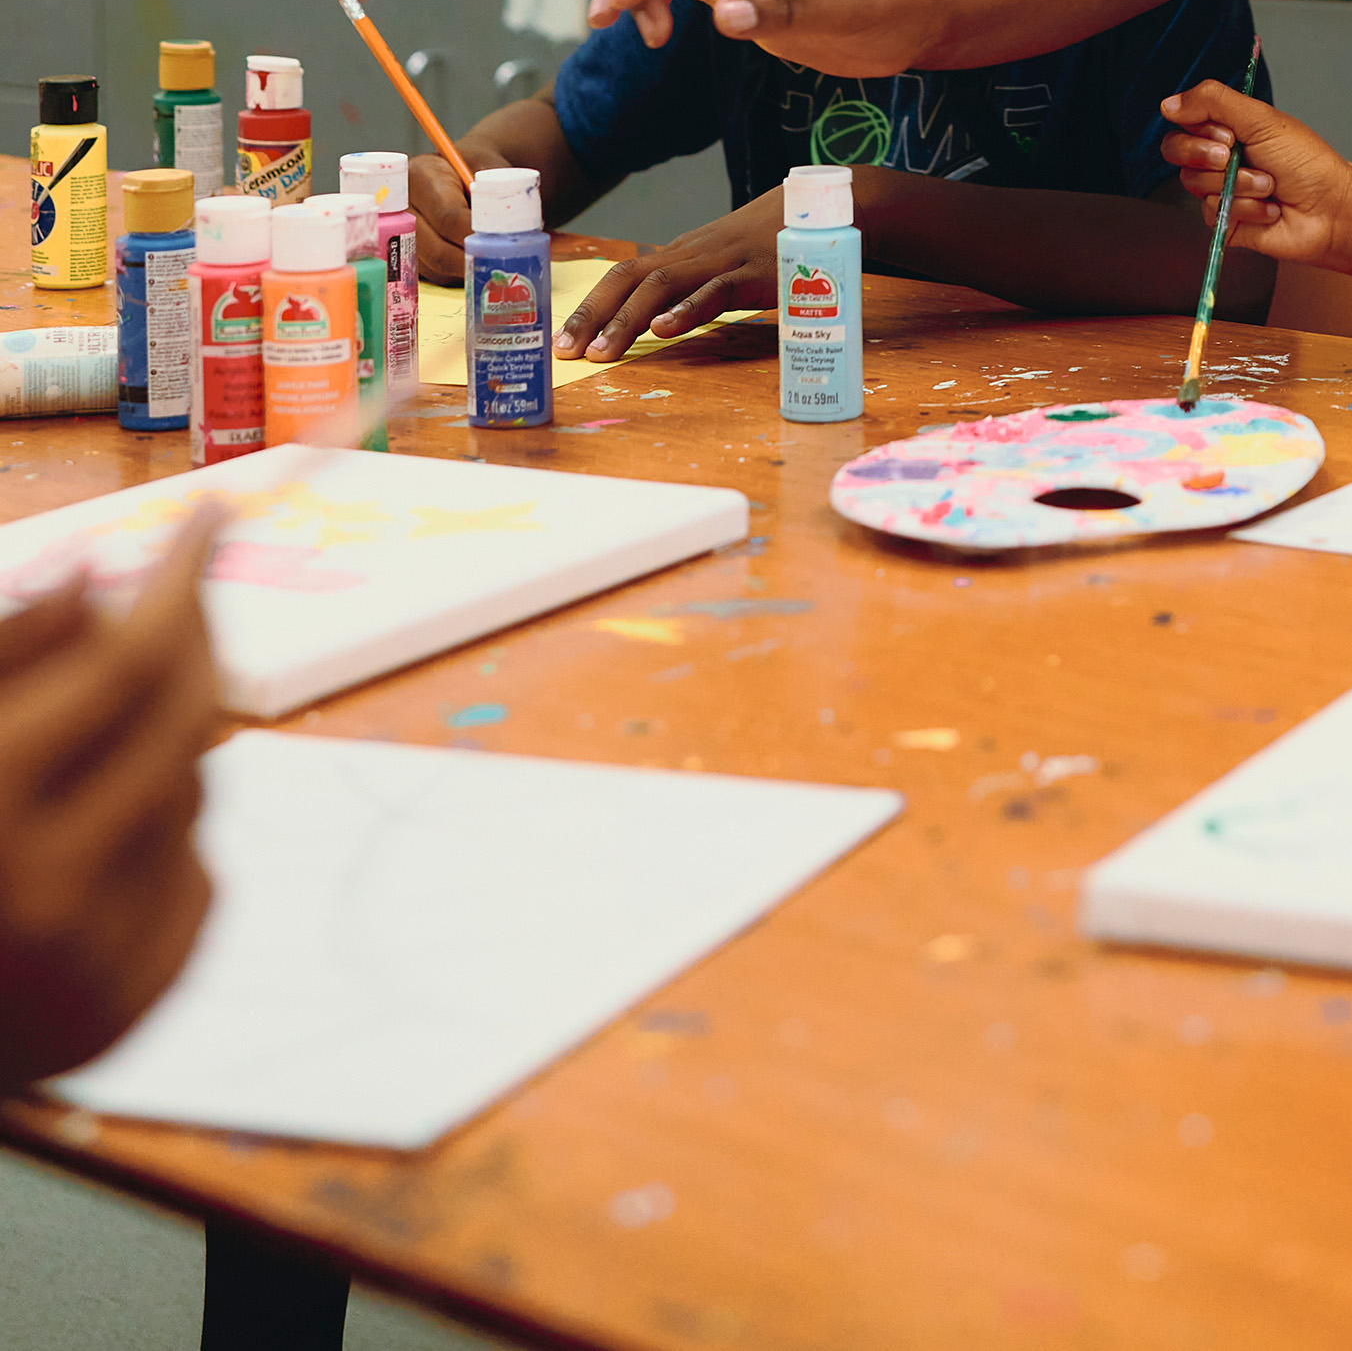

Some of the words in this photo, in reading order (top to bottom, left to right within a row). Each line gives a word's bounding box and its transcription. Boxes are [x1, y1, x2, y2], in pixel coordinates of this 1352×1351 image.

[258, 184, 277, 200] by
[476, 335, 513, 346] Concord
[792, 330, 812, 340] Aqua
[815, 330, 832, 340] Sky
[483, 400, 489, 413] 2
[514, 397, 539, 413] 59ml
[788, 390, 793, 404] 2
[794, 391, 800, 404] fl
[802, 394, 812, 405] oz
[814, 391, 839, 405] 59ml
